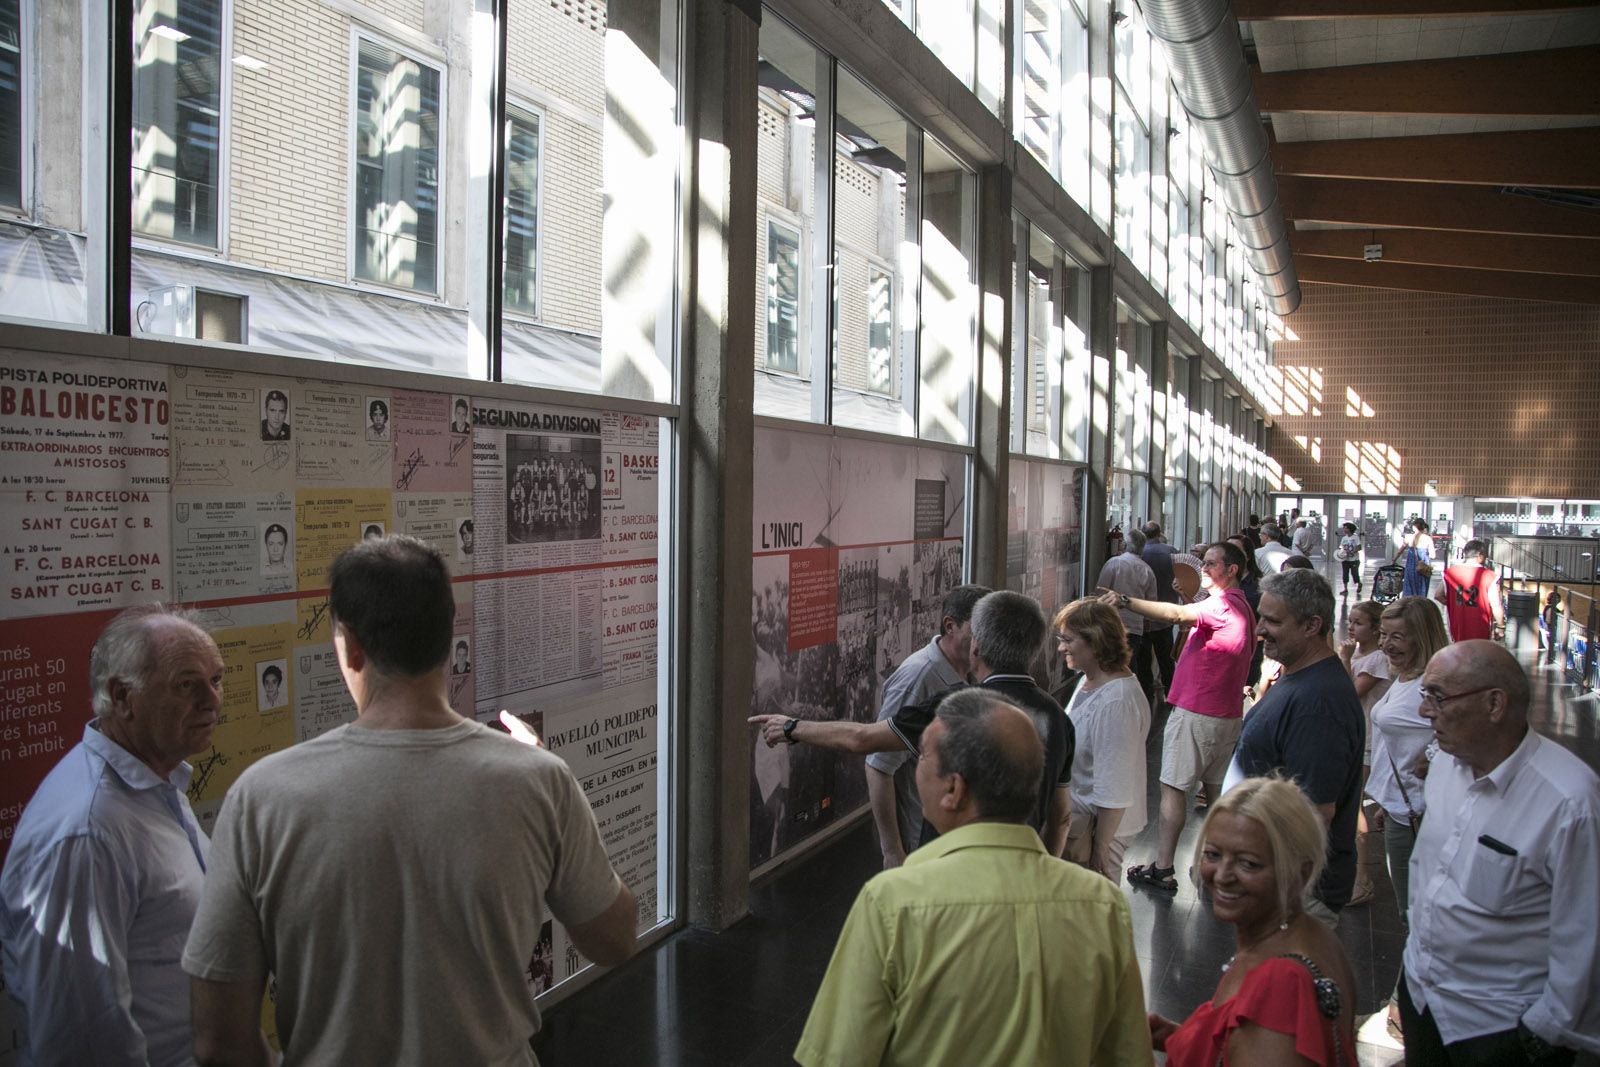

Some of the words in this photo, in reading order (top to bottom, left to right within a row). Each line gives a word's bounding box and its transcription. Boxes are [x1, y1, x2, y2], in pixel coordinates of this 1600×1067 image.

[0, 367, 48, 383] PISTA
[53, 371, 168, 393] POLIDEPORTIVA
[0, 386, 169, 425] BALONCESTO
[472, 407, 541, 429] SEGUNDA
[543, 414, 601, 433] DIVISION
[35, 427, 43, 436] 17
[45, 428, 54, 437] de
[56, 429, 96, 439] Septiembre
[151, 433, 169, 441] Tarde
[0, 441, 102, 455] EXTRAORDINARIOS
[109, 446, 170, 457] ENCUENTROS
[54, 458, 127, 469] AMISTOSOS
[604, 469, 615, 482] 12
[26, 490, 37, 502] F.
[45, 490, 57, 502] C.
[66, 490, 150, 503] BARCELONA
[22, 518, 62, 530] SANT
[70, 517, 117, 529] CUGAT
[124, 517, 136, 528] C.
[143, 517, 153, 528] B.
[619, 532, 637, 542] SANT
[762, 522, 803, 549] L'INICI
[28, 545, 38, 553] 20
[14, 558, 29, 571] F.
[37, 557, 53, 570] C.
[61, 553, 161, 569] BARCELONA
[11, 584, 60, 600] SANT
[67, 581, 123, 596] CUGAT
[131, 580, 144, 592] C.
[151, 579, 165, 590] B.
[619, 576, 637, 587] SANT
[616, 622, 637, 635] SANT
[46, 657, 66, 676] 50
[48, 680, 66, 695] en
[27, 720, 58, 737] han
[547, 718, 600, 751] PAVELLÓ
[604, 703, 658, 732] POLIDEPO
[18, 735, 65, 758] àmbit
[585, 726, 648, 758] MUNICIPAL
[583, 780, 594, 791] DE
[597, 775, 607, 786] LA
[611, 765, 635, 780] POSTA
[638, 759, 648, 770] EN
[605, 794, 611, 804] 3
[615, 790, 621, 799] 4
[620, 788, 628, 798] DE
[630, 783, 645, 795] JUNY
[615, 804, 641, 821] DISSABTE
